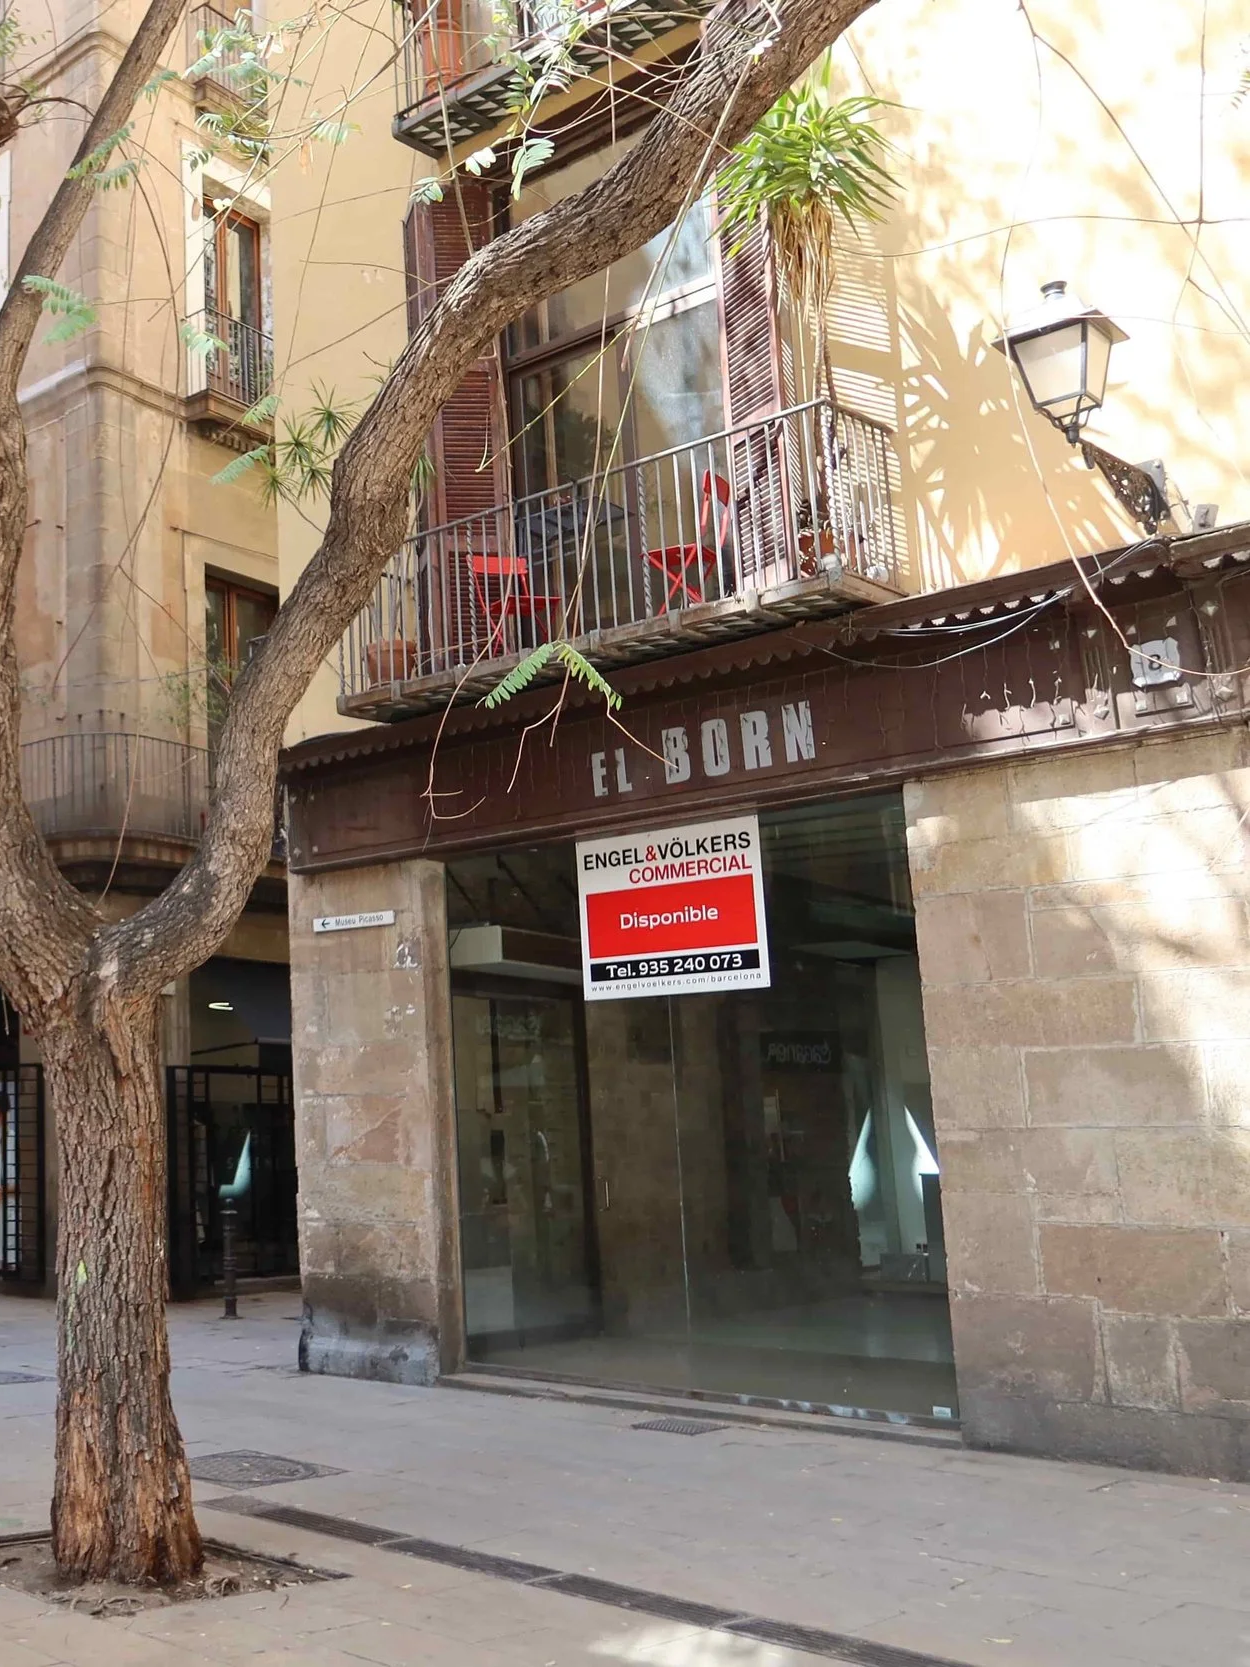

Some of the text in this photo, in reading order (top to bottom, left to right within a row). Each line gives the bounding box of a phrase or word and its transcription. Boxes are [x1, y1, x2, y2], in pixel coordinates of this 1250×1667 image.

[1148, 654, 1162, 671] 8
[591, 700, 816, 797] EL BORN
[583, 831, 751, 871] ENGEL&VÖLKERS
[629, 854, 752, 884] COMMERCIAL
[335, 914, 384, 927] Museu Picasso
[619, 904, 719, 930] Disponible
[605, 953, 743, 978] Tel. 935 240 073
[591, 971, 762, 992] www.engelvoelkers.com/barcelona
